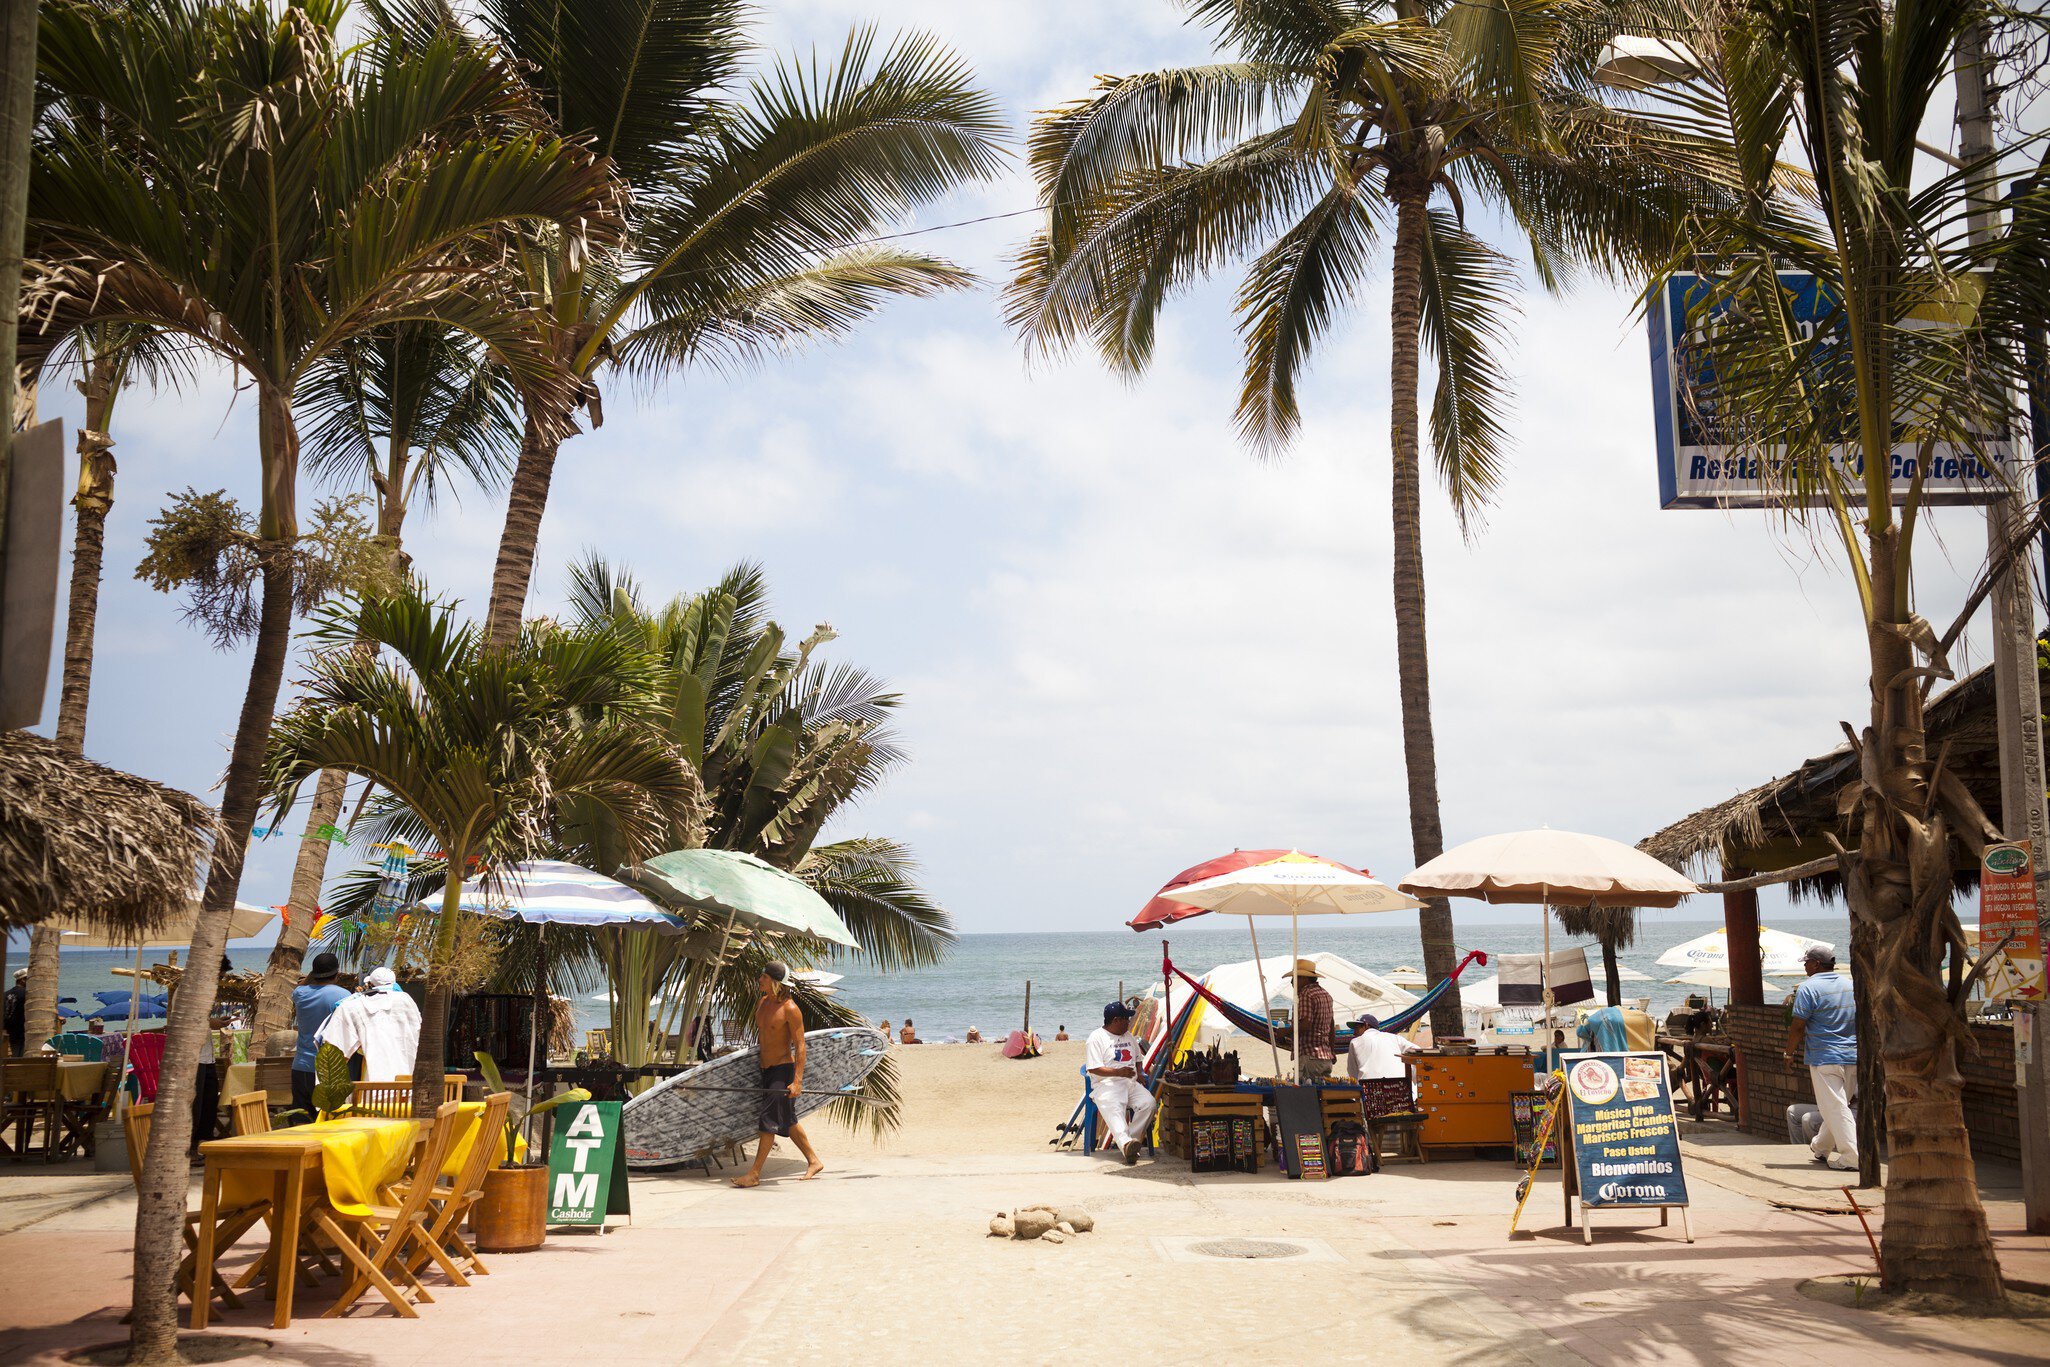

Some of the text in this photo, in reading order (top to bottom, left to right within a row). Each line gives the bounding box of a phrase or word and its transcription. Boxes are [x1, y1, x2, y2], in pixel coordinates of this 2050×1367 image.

[1686, 949, 1725, 960] Corona
[1595, 1105, 1654, 1121] Música Viva
[1576, 1113, 1674, 1135] Margaritas Grandes
[1583, 1125, 1670, 1144] Mariscos Frescos
[552, 1104, 605, 1208] ATM
[1603, 1145, 1656, 1157] Pase Usted
[1591, 1160, 1674, 1177] Bienvenidos
[1598, 1181, 1667, 1203] Corona
[551, 1208, 593, 1219] Cashola
